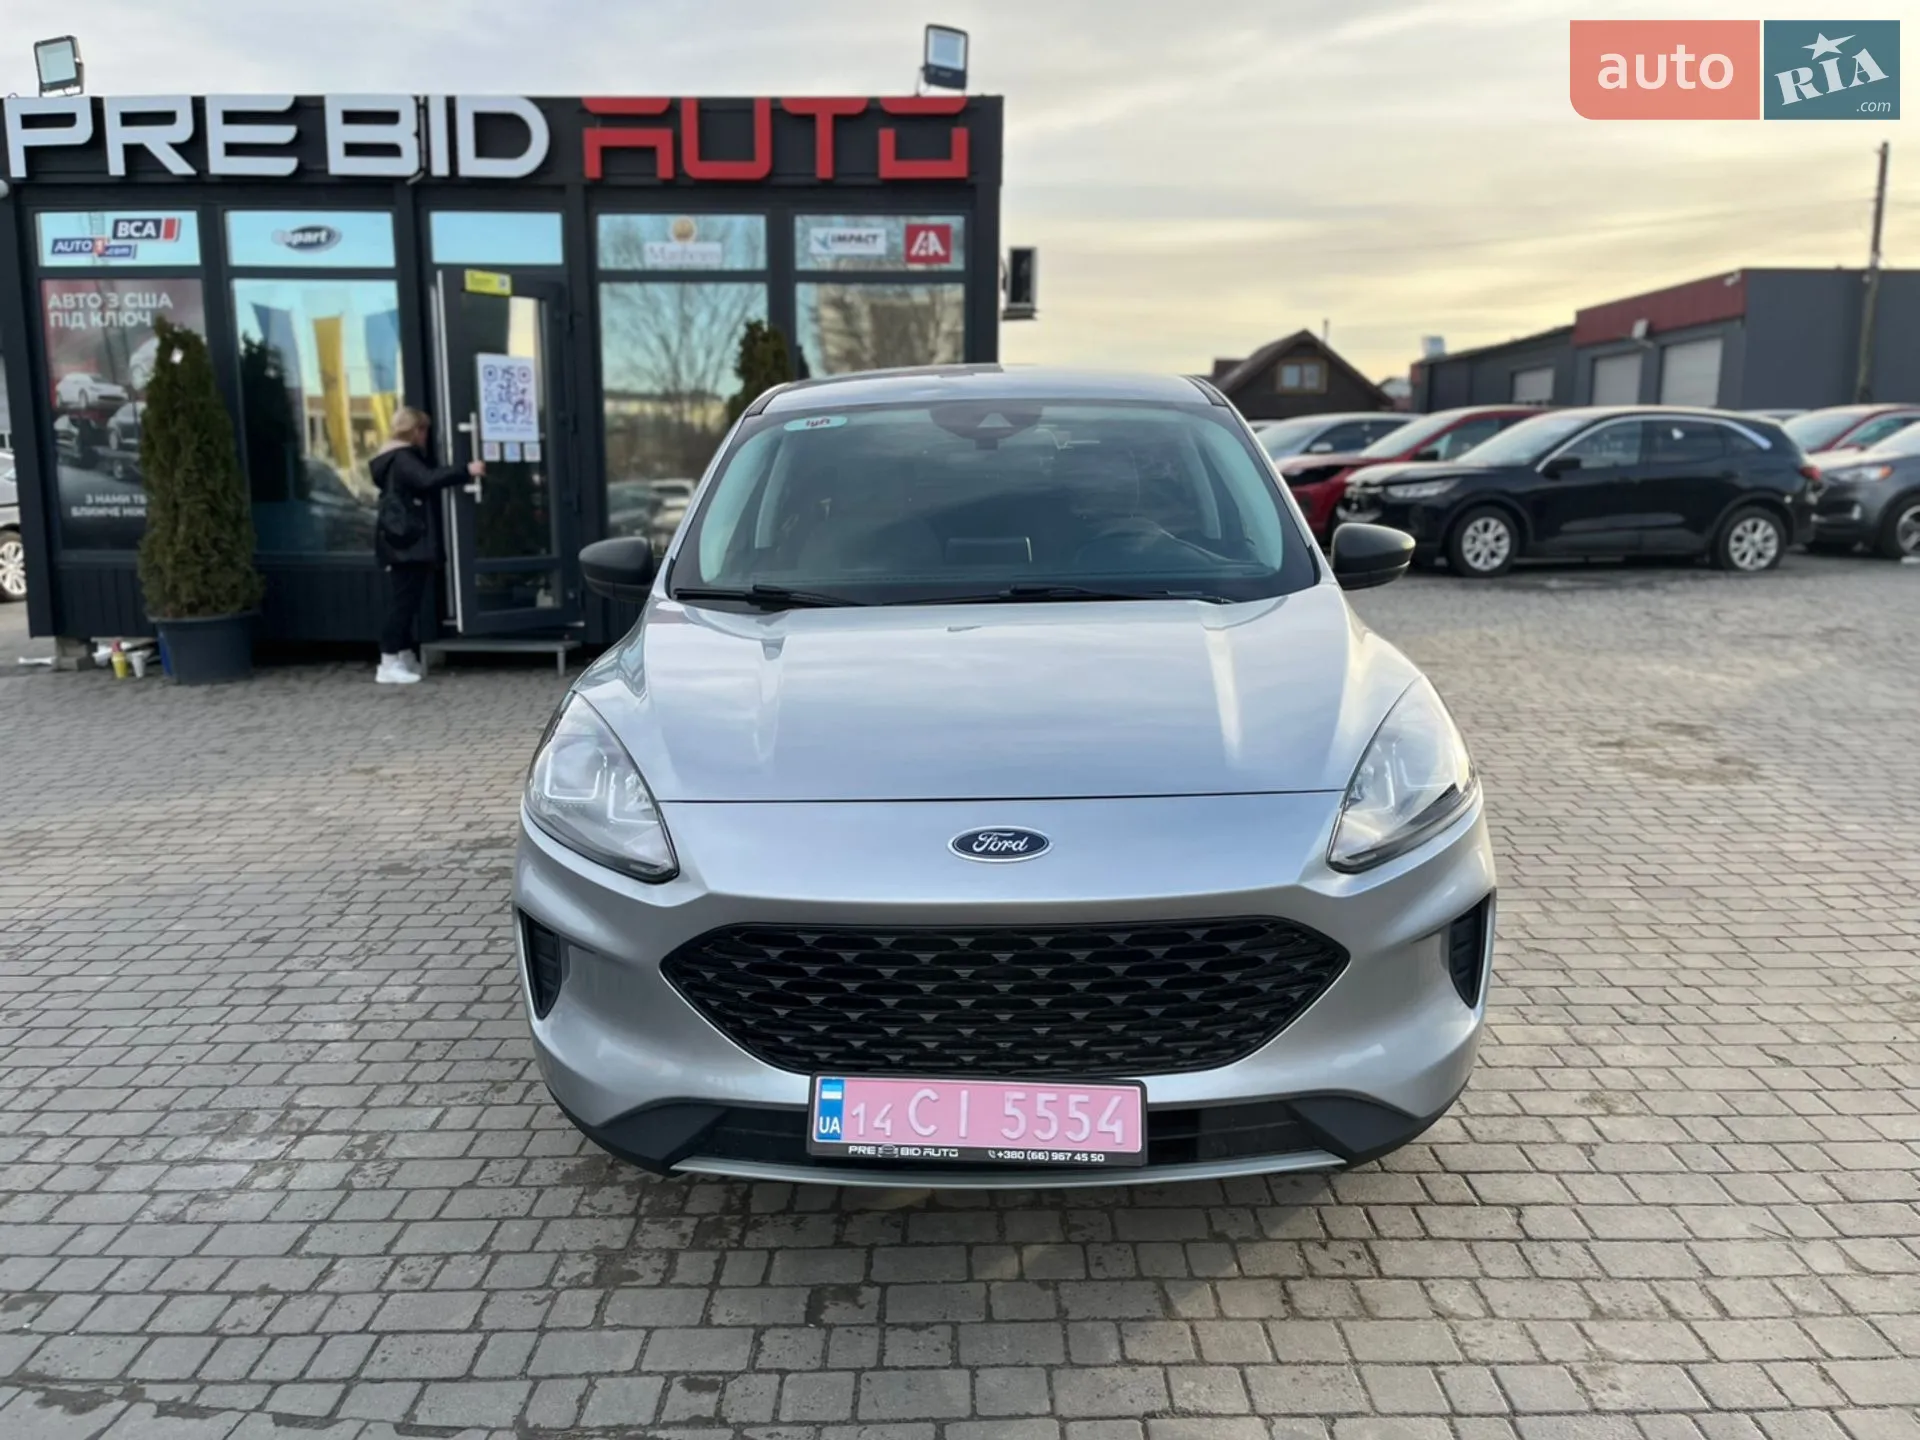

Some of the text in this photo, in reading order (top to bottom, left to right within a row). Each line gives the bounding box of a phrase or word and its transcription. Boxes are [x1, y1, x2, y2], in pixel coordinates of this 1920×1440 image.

[581, 96, 969, 179] AUTO
[117, 221, 157, 237] BCA
[831, 233, 879, 245] IMPACT
[48, 292, 173, 309] АВТО З США
[49, 311, 151, 330] ПІД КЛЮЧ
[972, 832, 1028, 852] Ford
[818, 1116, 841, 1134] UA
[999, 1091, 1126, 1144] 5554
[848, 1145, 959, 1157] PRE BID AUTO
[997, 1150, 1025, 1160] +380
[1074, 1152, 1089, 1162] 45
[1090, 1153, 1105, 1163] 50
